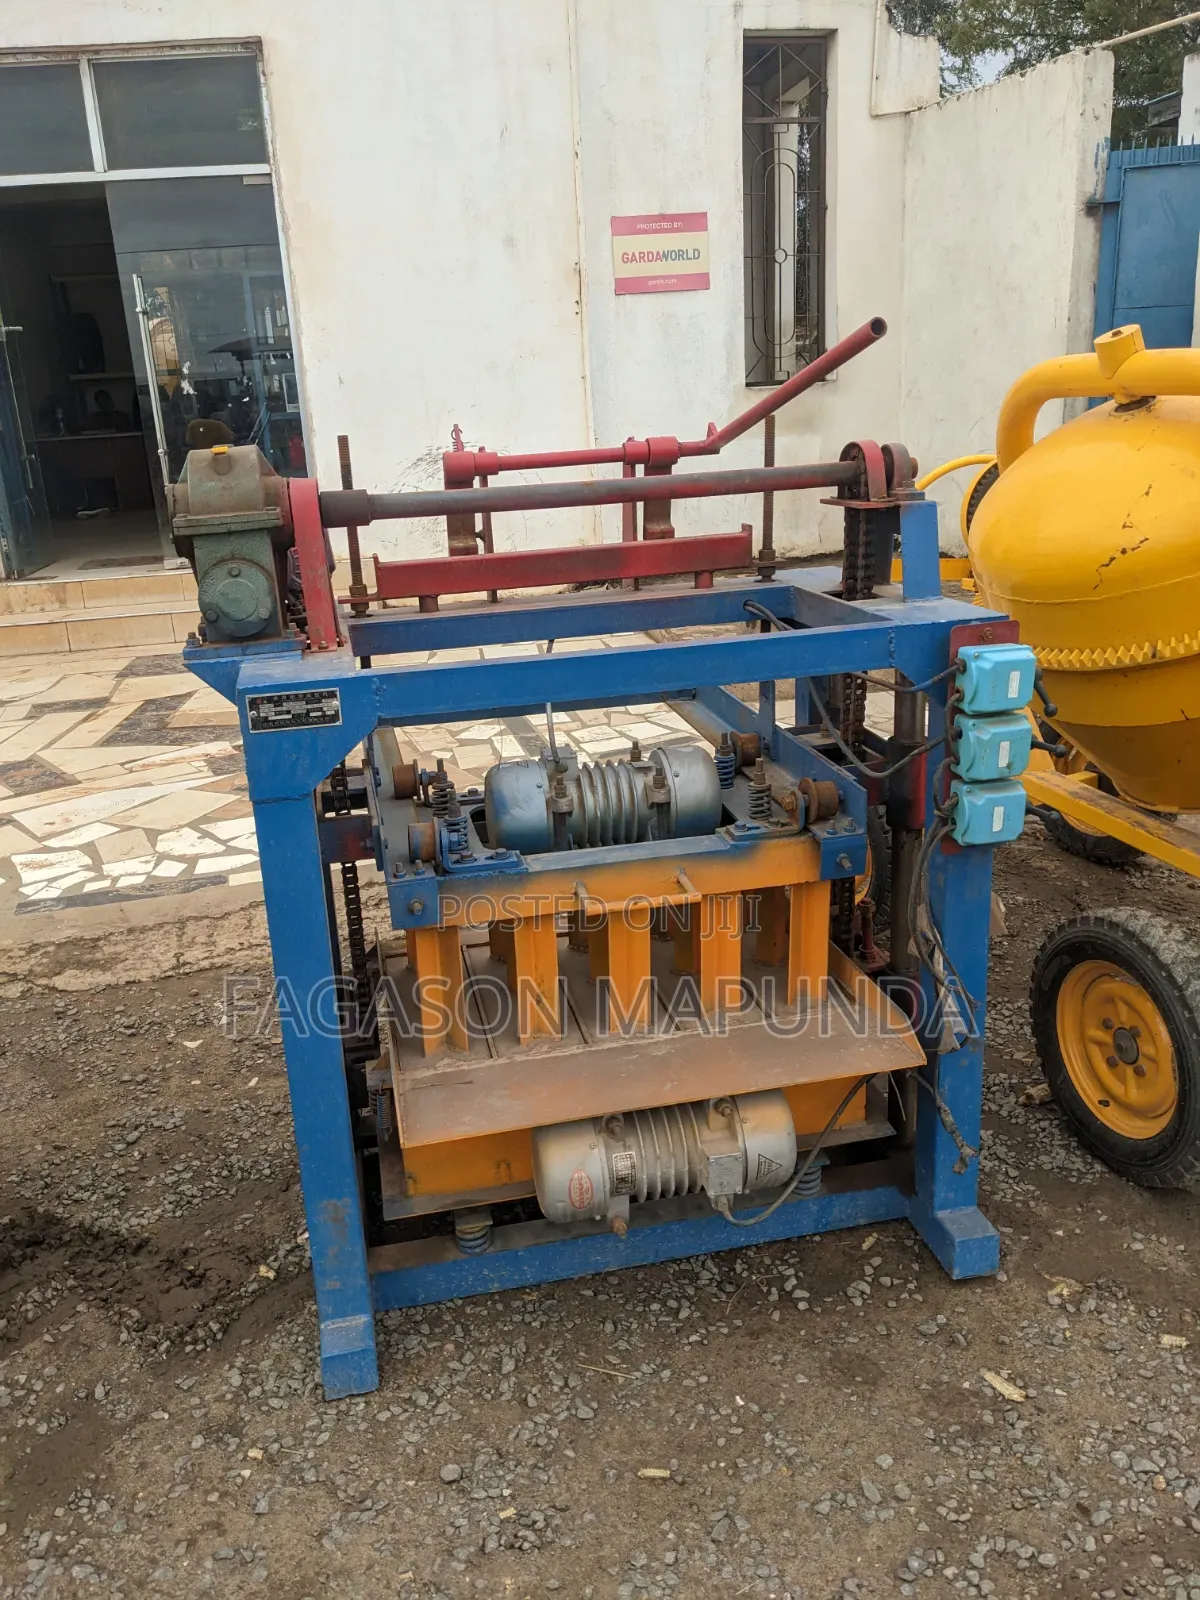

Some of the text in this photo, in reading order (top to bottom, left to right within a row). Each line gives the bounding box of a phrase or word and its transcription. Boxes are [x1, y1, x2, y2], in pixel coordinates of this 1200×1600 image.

[636, 221, 683, 230] PROTECTED BY:
[621, 248, 701, 264] GARDAWORLD
